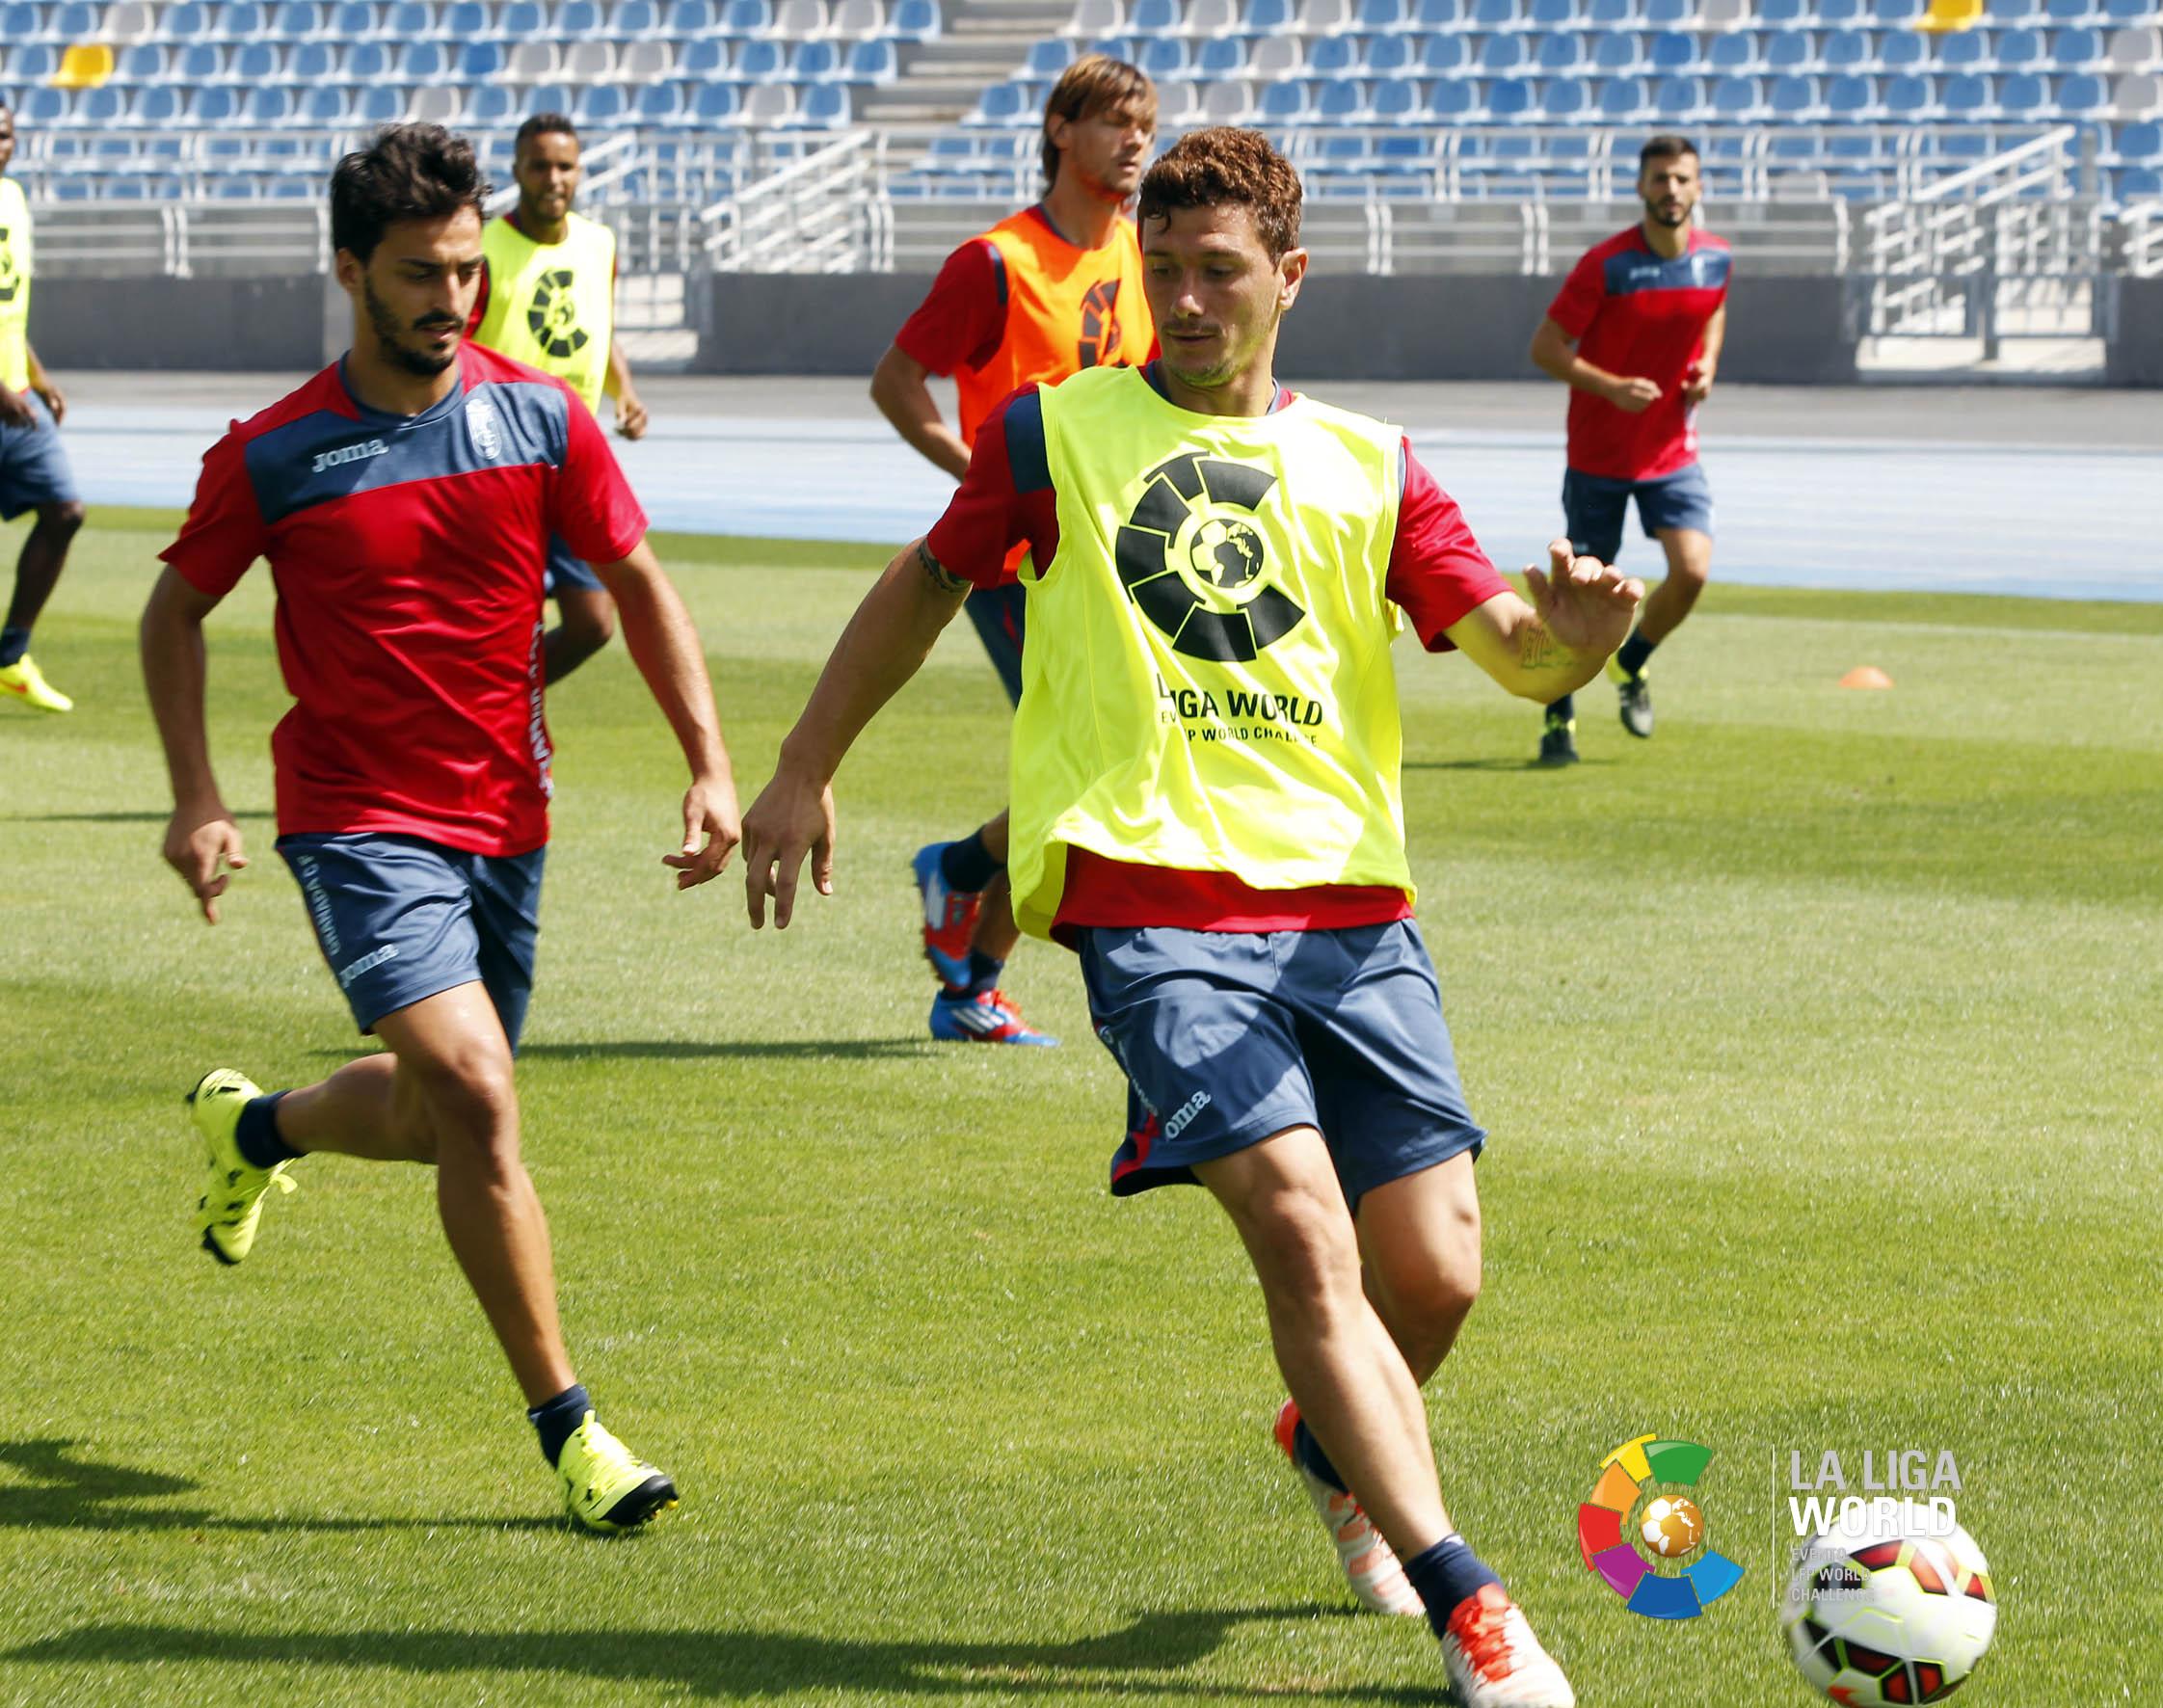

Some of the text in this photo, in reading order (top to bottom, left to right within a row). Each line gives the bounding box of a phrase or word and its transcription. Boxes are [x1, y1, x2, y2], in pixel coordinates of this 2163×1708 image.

[311, 439, 388, 473] Joma
[1226, 689, 1323, 727] WORLD
[1164, 1090, 1212, 1140] oma
